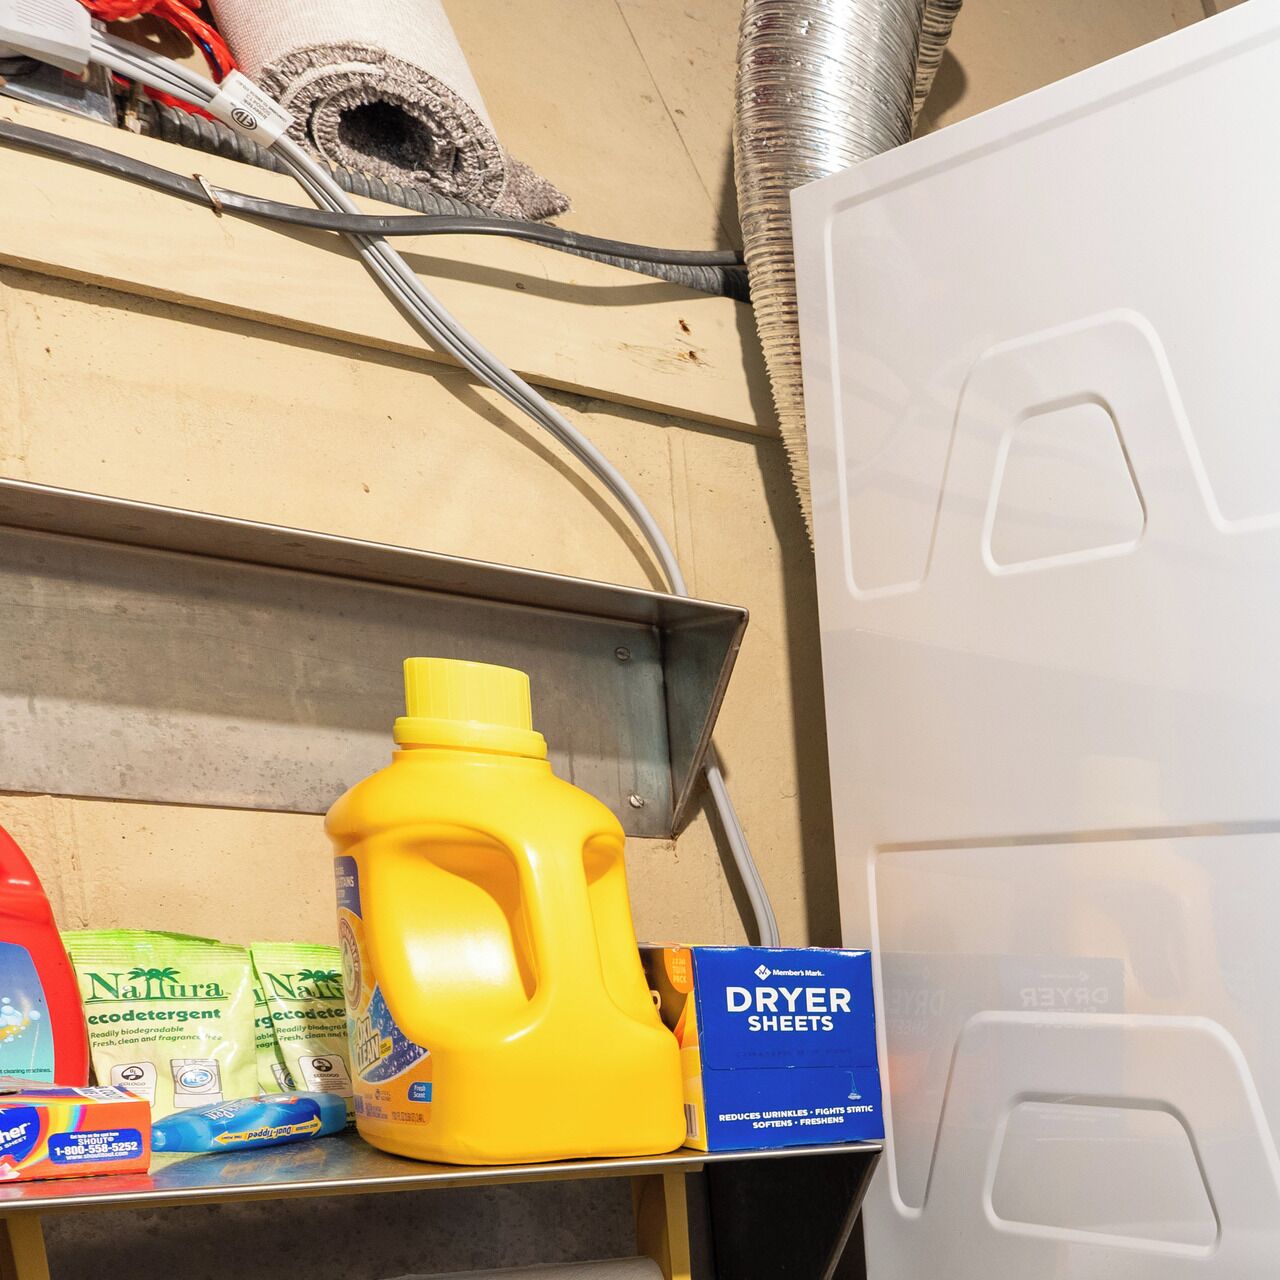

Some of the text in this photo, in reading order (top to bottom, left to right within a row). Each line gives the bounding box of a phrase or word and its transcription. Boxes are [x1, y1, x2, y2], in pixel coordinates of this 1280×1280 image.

[772, 969, 822, 977] Member's Mark
[84, 967, 223, 1000] Natura
[726, 986, 851, 1012] DRYER
[88, 1009, 221, 1025] ecodetergent
[748, 1015, 833, 1031] SHEETS
[90, 1026, 184, 1039] Readily biodegradable
[277, 1024, 306, 1033] Readily
[118, 1037, 139, 1045] clean
[4, 1068, 25, 1076] cleaning
[719, 1105, 874, 1122] REDUCES WRINKLES FIGHTS STATIC
[753, 1116, 844, 1129] SOFTENS FRESHENS
[247, 1126, 292, 1140] Dual-Tipped
[55, 1141, 138, 1156] 1-800-558-5252
